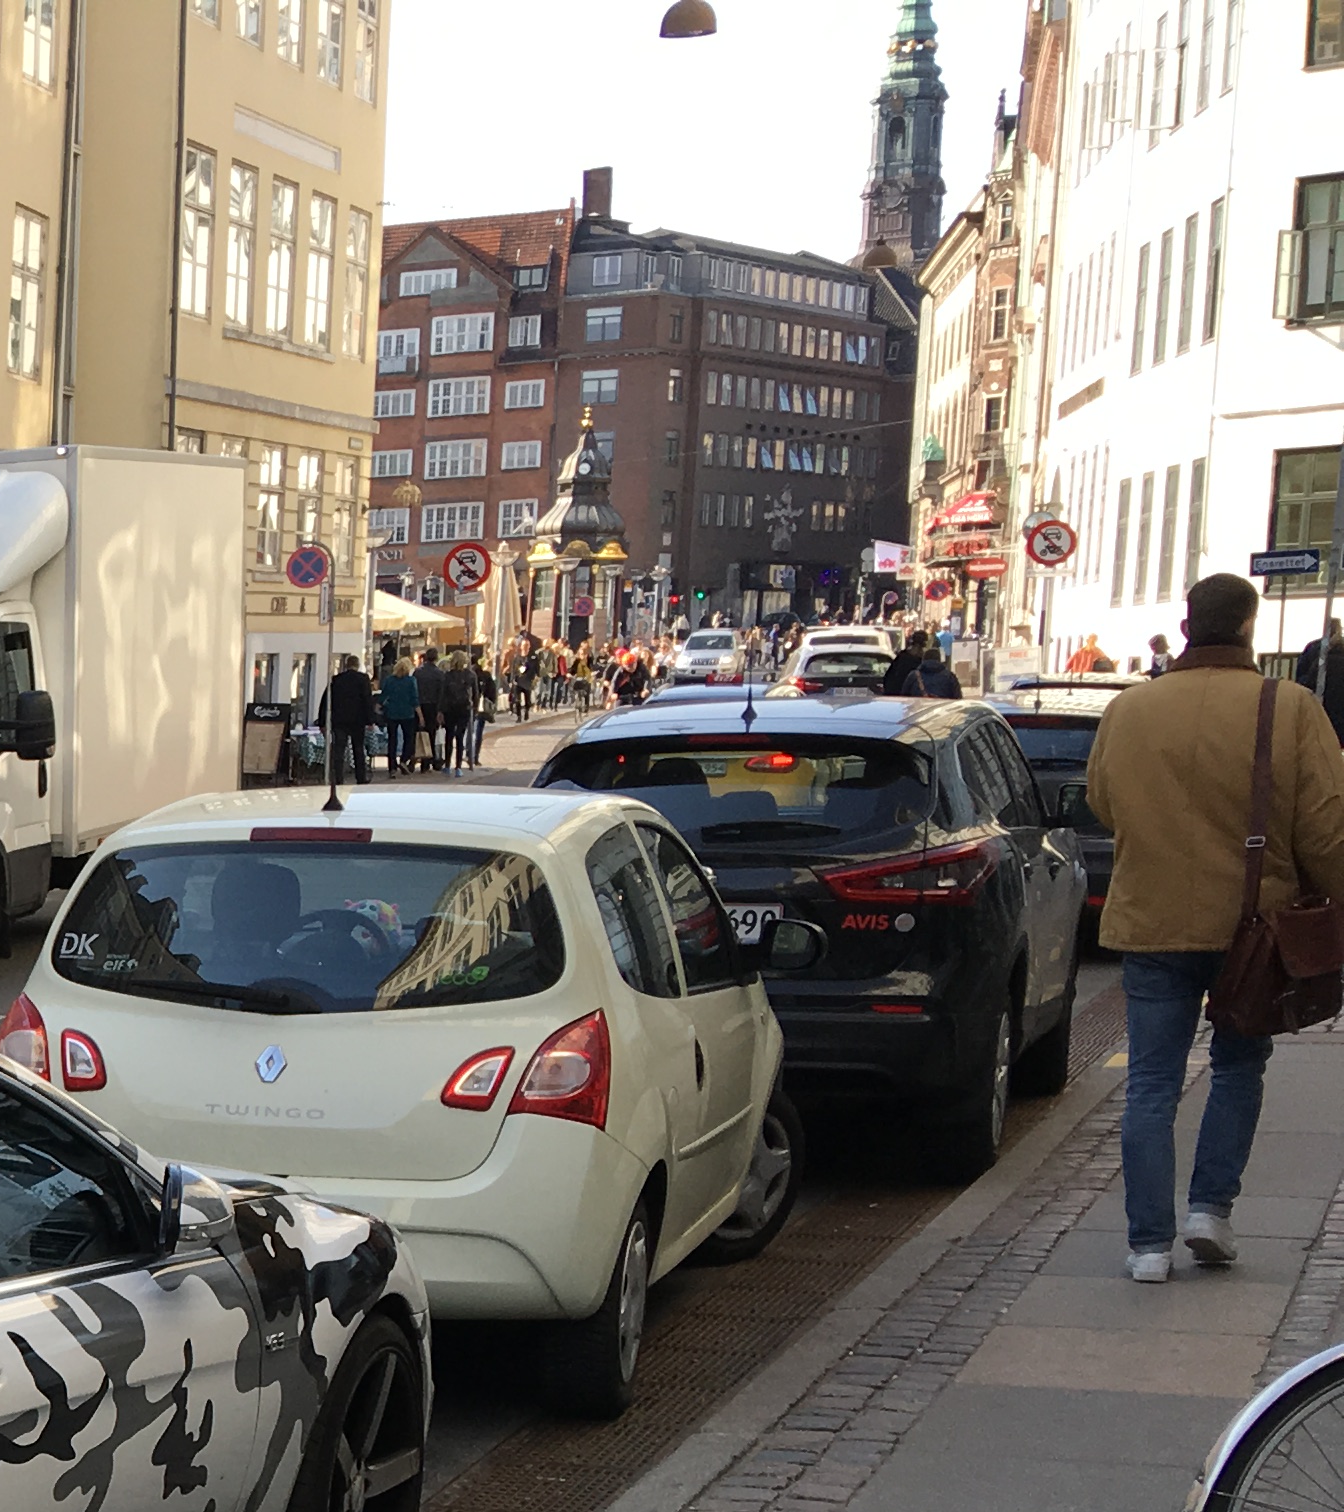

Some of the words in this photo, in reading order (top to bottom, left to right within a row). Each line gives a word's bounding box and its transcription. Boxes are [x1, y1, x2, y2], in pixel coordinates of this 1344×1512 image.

[841, 914, 890, 931] AVIS
[60, 932, 100, 956] DK
[102, 960, 126, 971] elf
[205, 1103, 326, 1120] TWINGO
